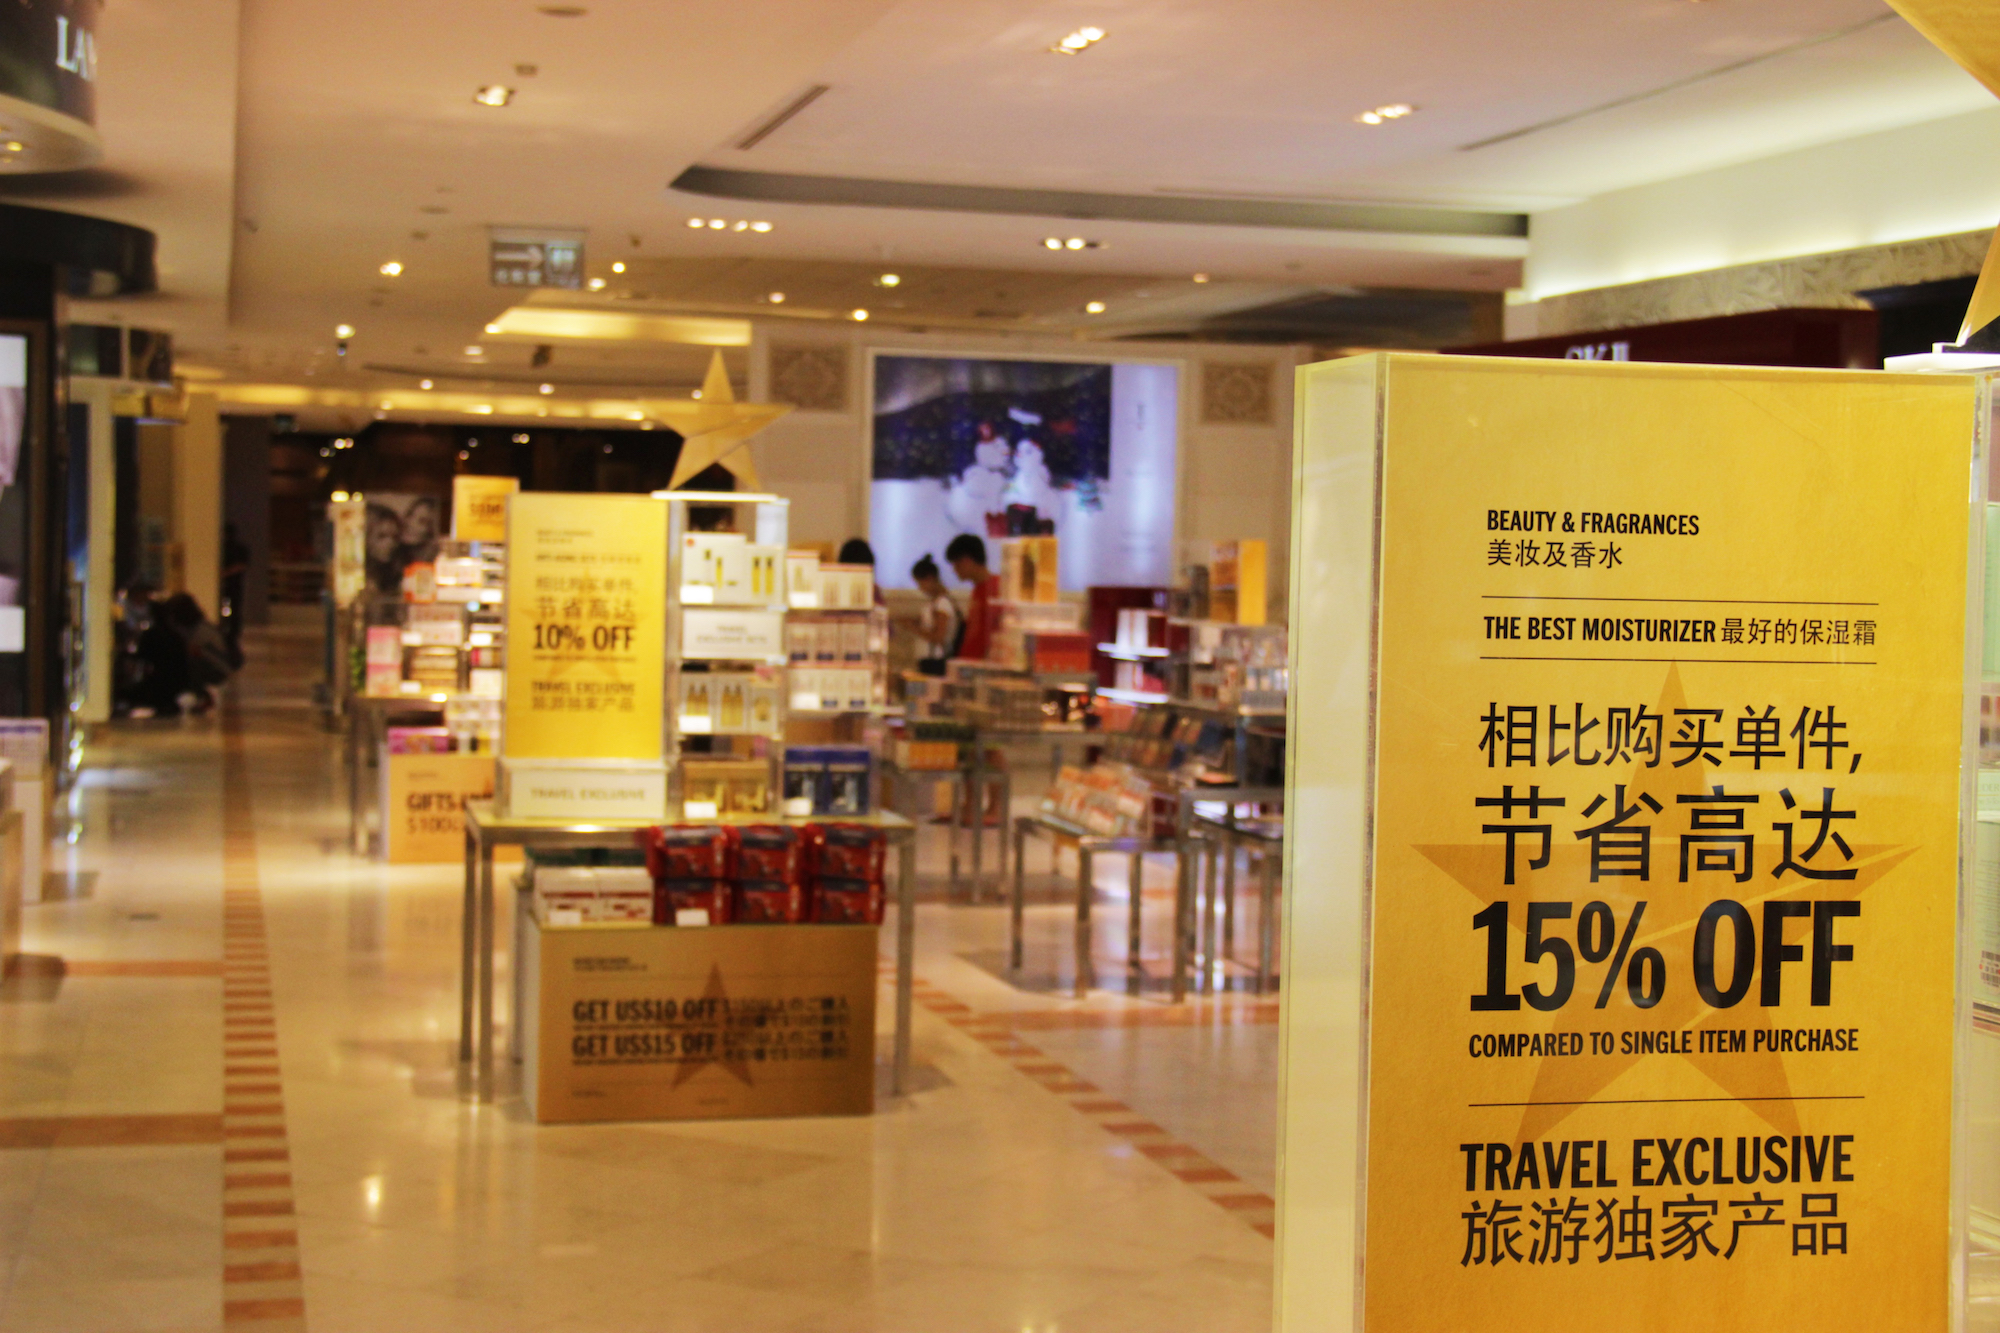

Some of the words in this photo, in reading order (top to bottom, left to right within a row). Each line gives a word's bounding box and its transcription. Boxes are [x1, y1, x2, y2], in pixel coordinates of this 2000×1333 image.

[1486, 509, 1557, 533] BEAUTY
[1561, 511, 1576, 533] &
[1581, 511, 1700, 536] FRAGRANCES
[1486, 539, 1623, 569] 美妆及香水
[534, 624, 586, 649] 10%
[593, 626, 635, 650] OFF
[1483, 615, 1521, 640] THE
[1527, 616, 1577, 641] BEST
[1582, 617, 1716, 643] MOISTURIZER
[1720, 617, 1878, 646] 最好的保湿霜
[1474, 784, 1859, 886] 节省高达
[1470, 900, 1667, 1012] 15%
[1692, 899, 1861, 1009] OFF
[573, 1000, 608, 1022] GET
[683, 999, 717, 1020] OFF
[572, 1034, 608, 1057] GET
[682, 1033, 715, 1054] OFF
[1468, 1031, 1583, 1058] COMPARED
[1589, 1031, 1615, 1055] TO
[1620, 1030, 1692, 1055] SINGLE
[1699, 1029, 1747, 1054] ITEM
[1753, 1028, 1859, 1053] PURCHASE
[1459, 1140, 1618, 1192] TRAVEL
[1632, 1134, 1855, 1187] EXCLUSIVE
[1460, 1192, 1848, 1268] 旅游独家产品
